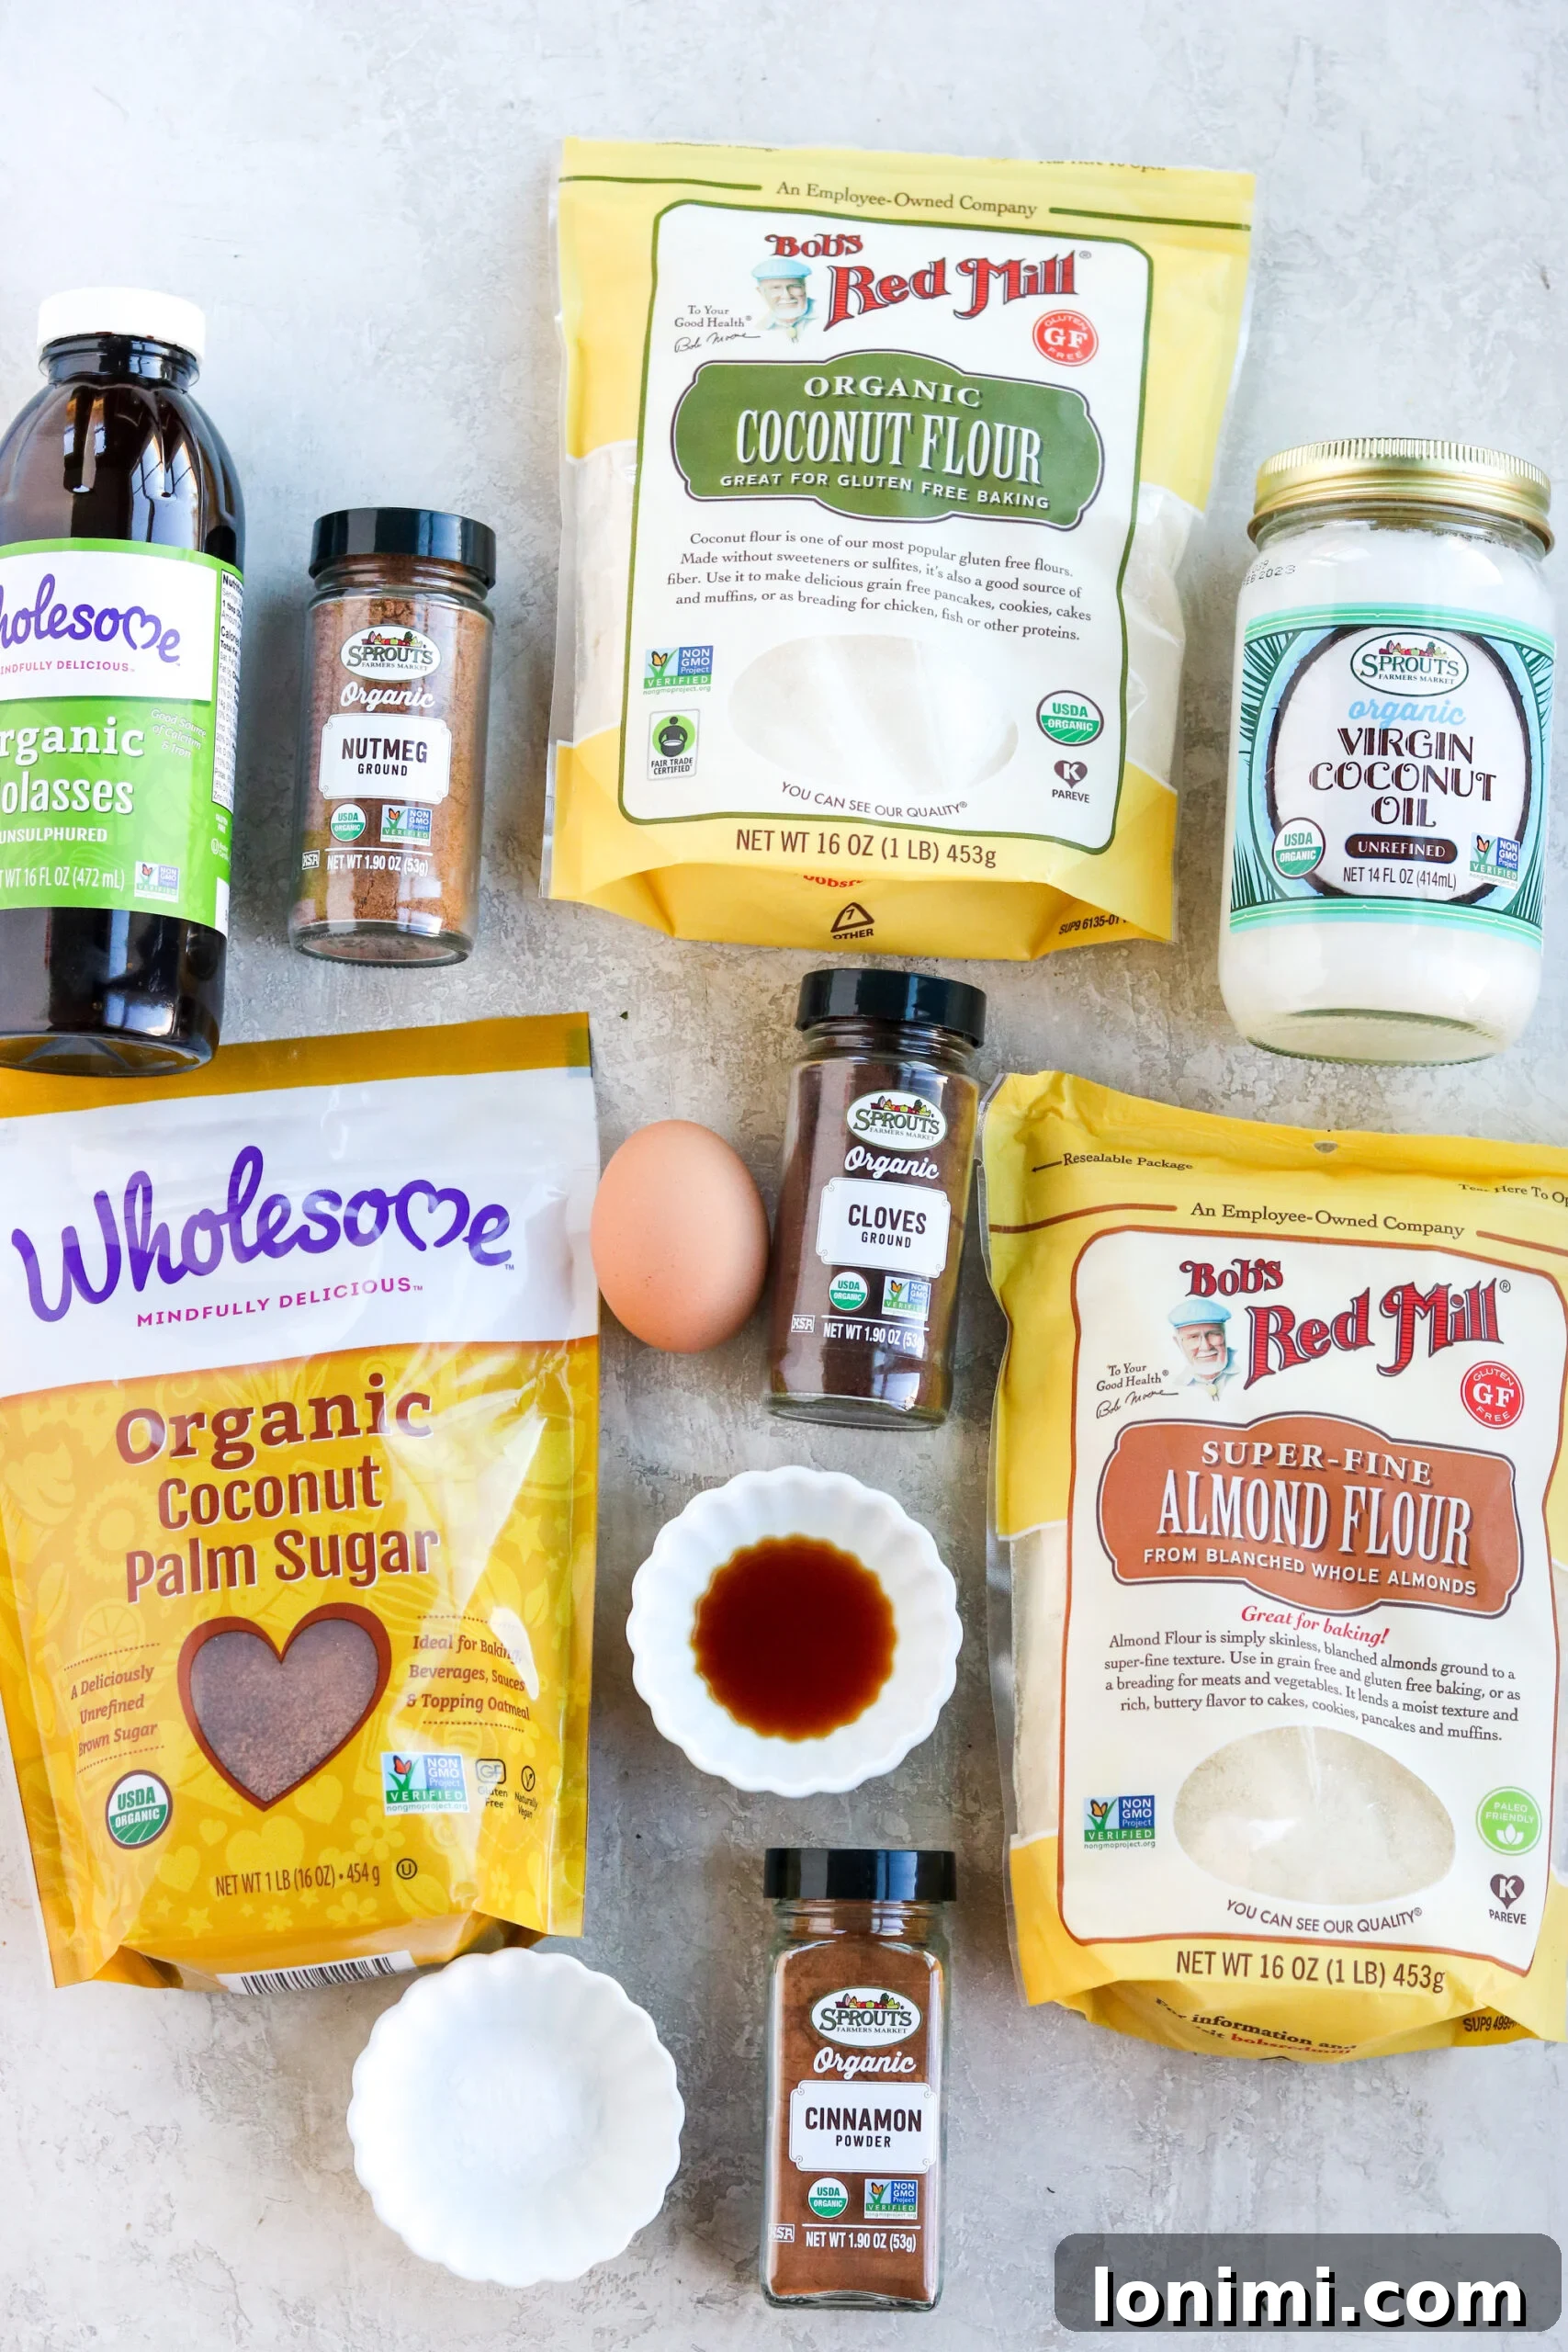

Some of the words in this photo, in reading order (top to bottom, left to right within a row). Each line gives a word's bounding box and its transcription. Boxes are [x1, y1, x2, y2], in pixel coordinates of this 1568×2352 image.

[776, 182, 800, 196] An
[807, 183, 953, 209] Employee-Owned
[959, 196, 1037, 219] Company
[764, 233, 863, 258] Bob's
[823, 256, 952, 332] Red
[674, 318, 704, 328] Good
[688, 305, 701, 315] To
[705, 305, 729, 315] Your
[804, 376, 982, 409] ORGANIC
[736, 409, 911, 466] COCONUT
[919, 413, 1042, 486] FLOUR
[720, 473, 783, 487] GREAT
[791, 472, 828, 485] FOR
[837, 475, 912, 492] GLUTEN
[921, 482, 968, 501] FREE
[977, 491, 1051, 509] BAKING
[690, 533, 746, 545] Coconut
[750, 530, 782, 542] flour
[785, 530, 795, 542] is
[800, 535, 823, 545] one
[828, 535, 843, 547] of
[845, 539, 868, 548] our
[873, 540, 904, 550] most
[908, 543, 956, 561] popular
[959, 552, 1000, 567] gluten
[1005, 556, 1030, 570] free
[1034, 558, 1073, 577] flours.
[346, 645, 434, 667] SPROUTS
[682, 649, 710, 658] NON
[682, 657, 710, 667] GMO
[1360, 654, 1460, 678] SPROUTS
[648, 677, 708, 687] VERIFIED
[1378, 673, 1417, 682] FARMERS
[1421, 676, 1455, 684] MARKET
[340, 681, 435, 712] Organic
[1052, 702, 1088, 718] USDA
[1047, 718, 1093, 732] ORGANIC
[1348, 698, 1466, 729] organic
[0, 716, 144, 766] rganic
[342, 738, 427, 763] NUTMEG
[1337, 728, 1473, 764] VIRGIN
[358, 763, 408, 776] GROUND
[651, 759, 668, 767] FAIR
[671, 757, 693, 765] TRADE
[0, 771, 134, 815] olasses
[1052, 788, 1089, 803] PAREVE
[1309, 762, 1496, 801] COCONUT
[781, 781, 812, 800] YOU
[814, 793, 845, 809] CAN
[849, 799, 872, 813] SEE
[874, 805, 902, 817] OUR
[1371, 797, 1437, 828] OIL
[736, 829, 774, 851] NET
[781, 831, 809, 853] WT
[818, 832, 840, 854] 16
[848, 834, 874, 856] OZ
[881, 837, 898, 859] (1
[908, 841, 940, 864] LB)
[947, 844, 997, 868] 453g
[1358, 841, 1446, 857] UNREFINED
[5, 870, 20, 888] WT
[25, 868, 36, 887] 16
[39, 867, 52, 886] FL
[54, 866, 70, 887] OZ
[73, 868, 98, 889] (472
[102, 869, 124, 891] mL)
[327, 854, 344, 870] NET
[346, 854, 362, 869] WT
[365, 855, 386, 870] 1.90
[388, 856, 401, 871] OZ
[404, 857, 428, 876] (53g)
[1343, 867, 1363, 882] NET
[1370, 869, 1380, 882] 14
[1384, 869, 1396, 883] FL
[1399, 870, 1413, 885] OZ
[1416, 870, 1457, 891] (414mL)
[832, 928, 874, 940] OTHER
[853, 1108, 940, 1135] SPROUTS
[844, 1146, 939, 1180] Organic
[1063, 1151, 1133, 1167] Resealable
[1136, 1158, 1193, 1171] Package
[848, 1204, 927, 1234] CLOVES
[861, 1231, 911, 1248] GROUND
[1179, 1257, 1284, 1297] Bob's
[137, 1297, 270, 1328] MINDFULLY
[1243, 1286, 1375, 1391] Red
[115, 1373, 434, 1470] Organic
[1201, 1440, 1433, 1487] SUPER-FINE
[157, 1455, 382, 1531] Coconut
[1156, 1468, 1329, 1551] ALMOND
[1337, 1482, 1472, 1567] FLOUR
[125, 1538, 258, 1603] Palm
[274, 1528, 440, 1589] Sugar
[1144, 1548, 1197, 1564] FROM
[1206, 1548, 1304, 1574] BLANCHED
[1311, 1564, 1380, 1583] WHOLE
[1388, 1572, 1477, 1596] ALMONDS
[1241, 1605, 1292, 1624] Great
[1293, 1612, 1319, 1631] for
[1323, 1618, 1391, 1648] baking!
[1109, 1632, 1160, 1648] Almond
[1165, 1631, 1201, 1645] Flour
[1206, 1631, 1216, 1644] is
[1221, 1631, 1266, 1647] simply
[1269, 1632, 1321, 1654] skinless,
[1324, 1642, 1377, 1666] blanched
[1381, 1655, 1438, 1672] almonds
[1440, 1663, 1488, 1677] ground
[1492, 1668, 1504, 1678] to
[1508, 1671, 1516, 1679] a
[71, 1686, 78, 1700] A
[80, 1665, 154, 1696] Deliciously
[80, 1694, 144, 1724] Unrefined
[113, 1723, 158, 1743] Sugar
[1484, 1811, 1535, 1825] FRIENDLY
[1494, 1802, 1528, 1813] PALEO
[216, 1874, 238, 1896] NET
[242, 1872, 261, 1893] WT
[276, 1870, 290, 1891] LB
[294, 1868, 312, 1891] (16
[315, 1865, 335, 1889] OZ)
[347, 1862, 369, 1883] 454
[373, 1866, 379, 1886] g
[819, 2007, 911, 2030] SPROUTS
[813, 2046, 916, 2080] Organic
[805, 2107, 922, 2132] CINNAMON
[835, 2136, 891, 2148] POWDER
[813, 2199, 842, 2208] ORGANIC
[817, 2187, 840, 2197] USDA
[806, 2231, 827, 2247] NET
[829, 2232, 845, 2247] WT
[848, 2233, 871, 2248] 1.90
[874, 2233, 886, 2248] OZ
[889, 2233, 916, 2253] (53g)
